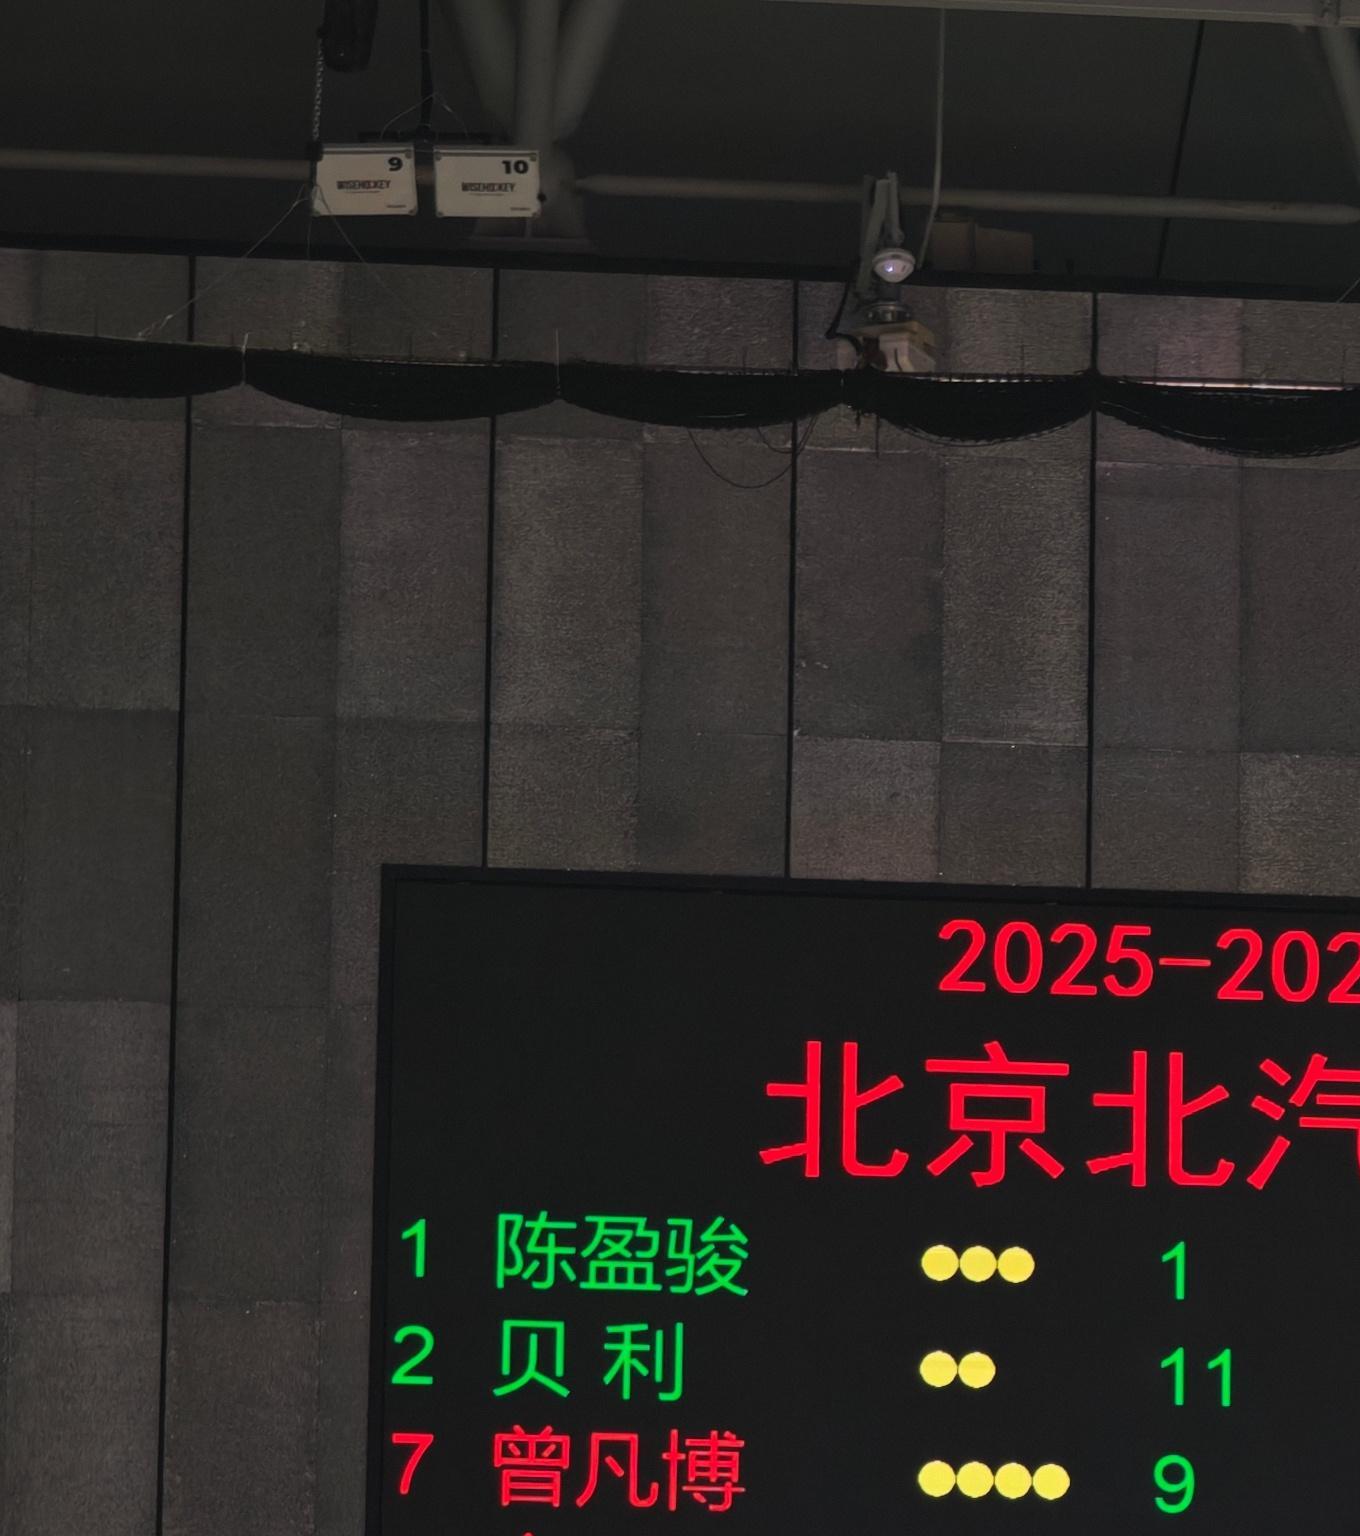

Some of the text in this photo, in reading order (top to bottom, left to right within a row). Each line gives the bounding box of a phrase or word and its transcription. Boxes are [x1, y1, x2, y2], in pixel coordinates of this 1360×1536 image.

[388, 156, 404, 172] 9
[501, 159, 529, 175] 10
[400, 1209, 1187, 1301] 1 陈盈骏 1
[390, 1324, 436, 1386] 2
[1159, 1346, 1233, 1408] 11
[390, 1423, 1196, 1515] 7 曾凡博 9
